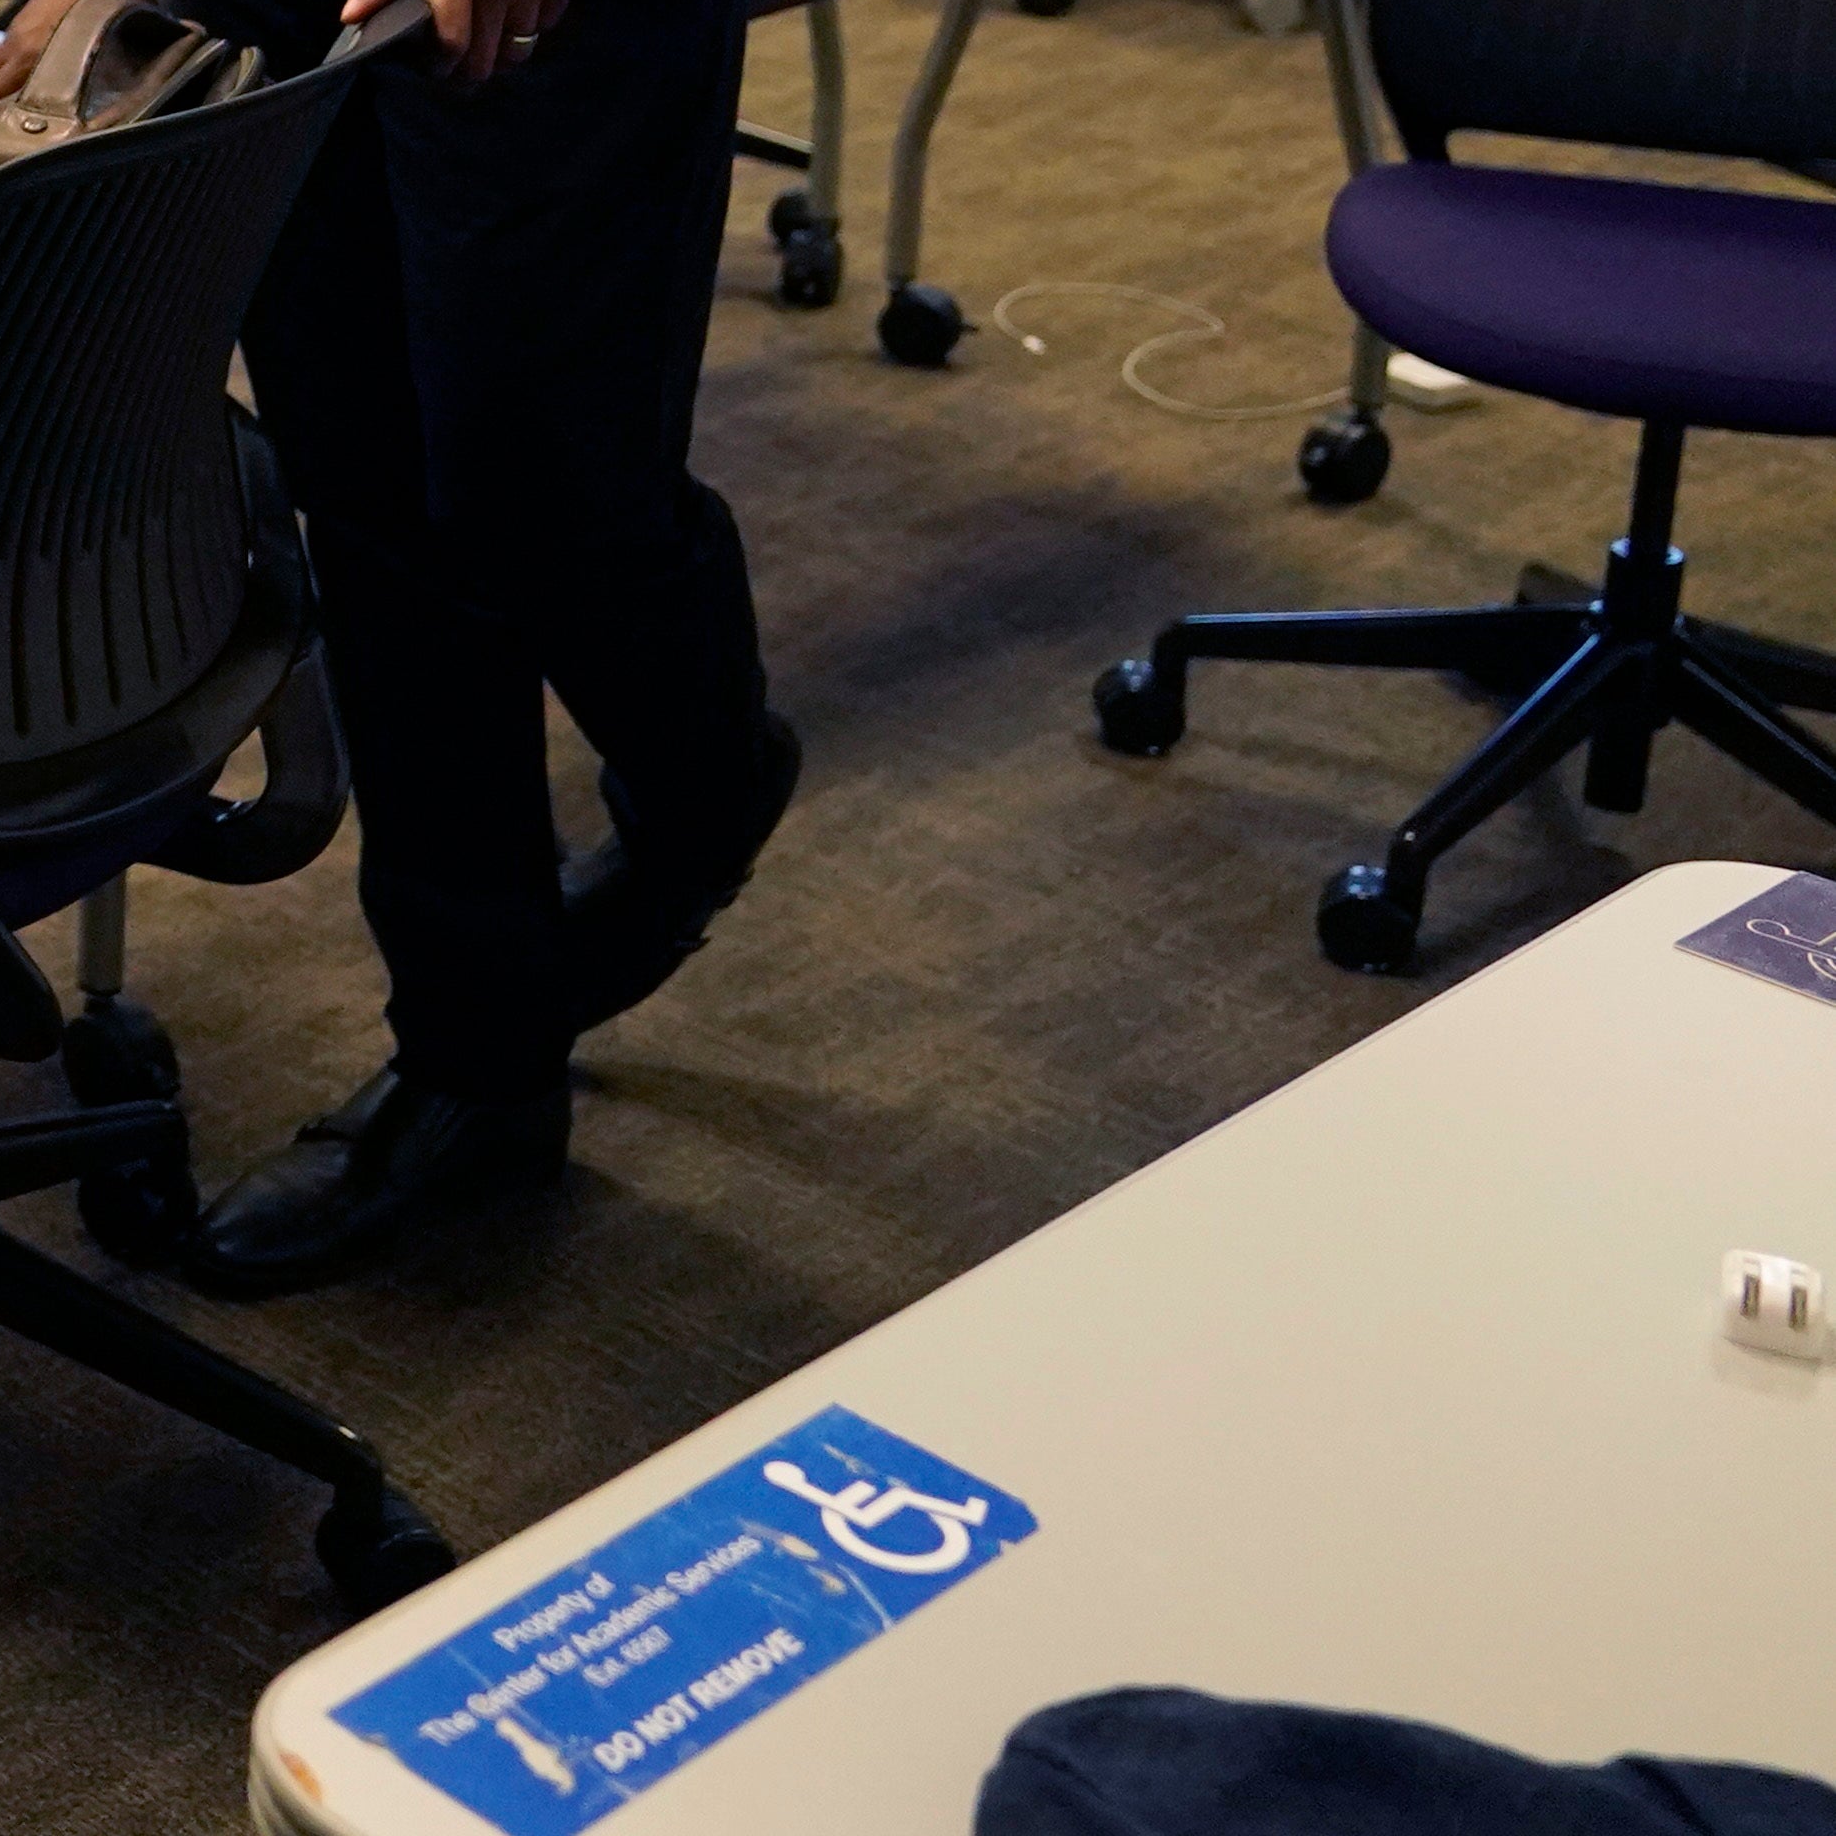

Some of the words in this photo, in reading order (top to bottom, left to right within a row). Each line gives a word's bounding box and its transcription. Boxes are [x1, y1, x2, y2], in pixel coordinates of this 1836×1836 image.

[419, 1710, 476, 1747] The
[467, 1664, 550, 1719] Center
[537, 1645, 577, 1676] for
[571, 1586, 678, 1657] Academic
[665, 1535, 762, 1597] Services
[492, 1590, 596, 1653] Property
[584, 1572, 615, 1600] of
[593, 1730, 646, 1774] DO
[633, 1693, 699, 1746] NOT
[688, 1627, 806, 1710] REMOVE
